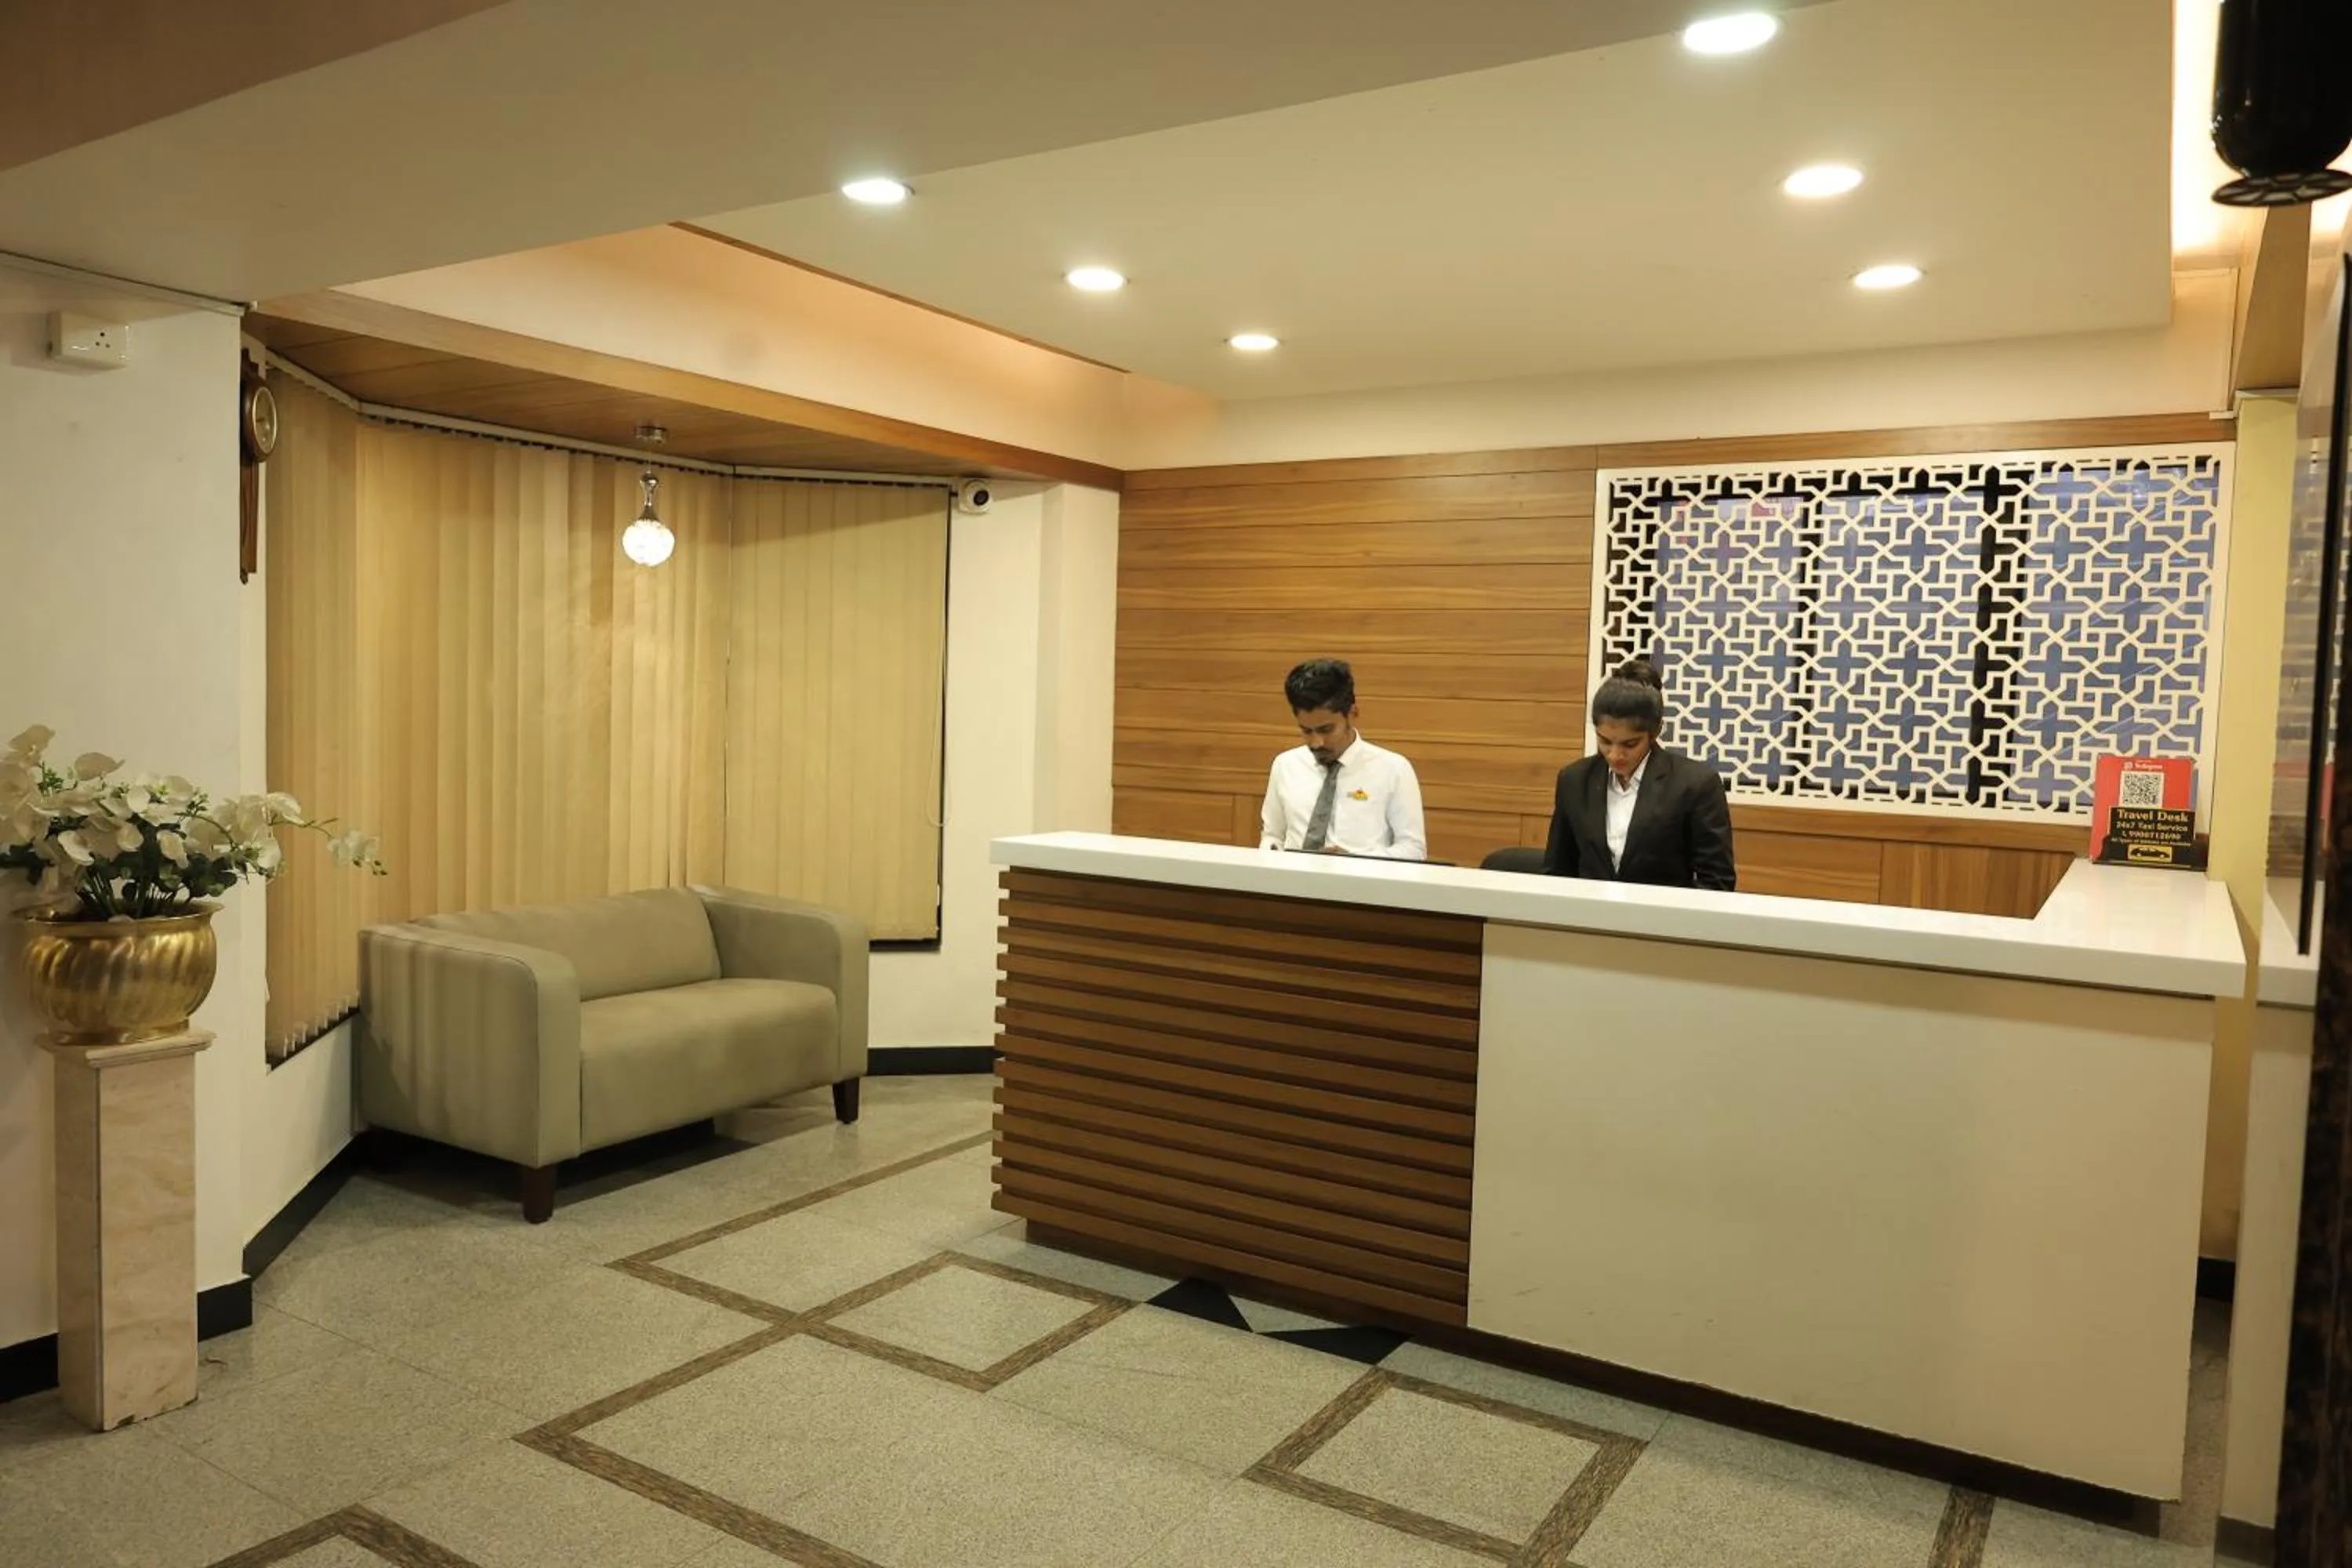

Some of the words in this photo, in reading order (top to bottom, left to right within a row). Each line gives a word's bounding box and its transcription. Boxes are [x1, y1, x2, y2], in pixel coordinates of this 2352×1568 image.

[2117, 809, 2154, 820] Travel
[2158, 811, 2188, 822] Desk
[2157, 822, 2188, 832] Service
